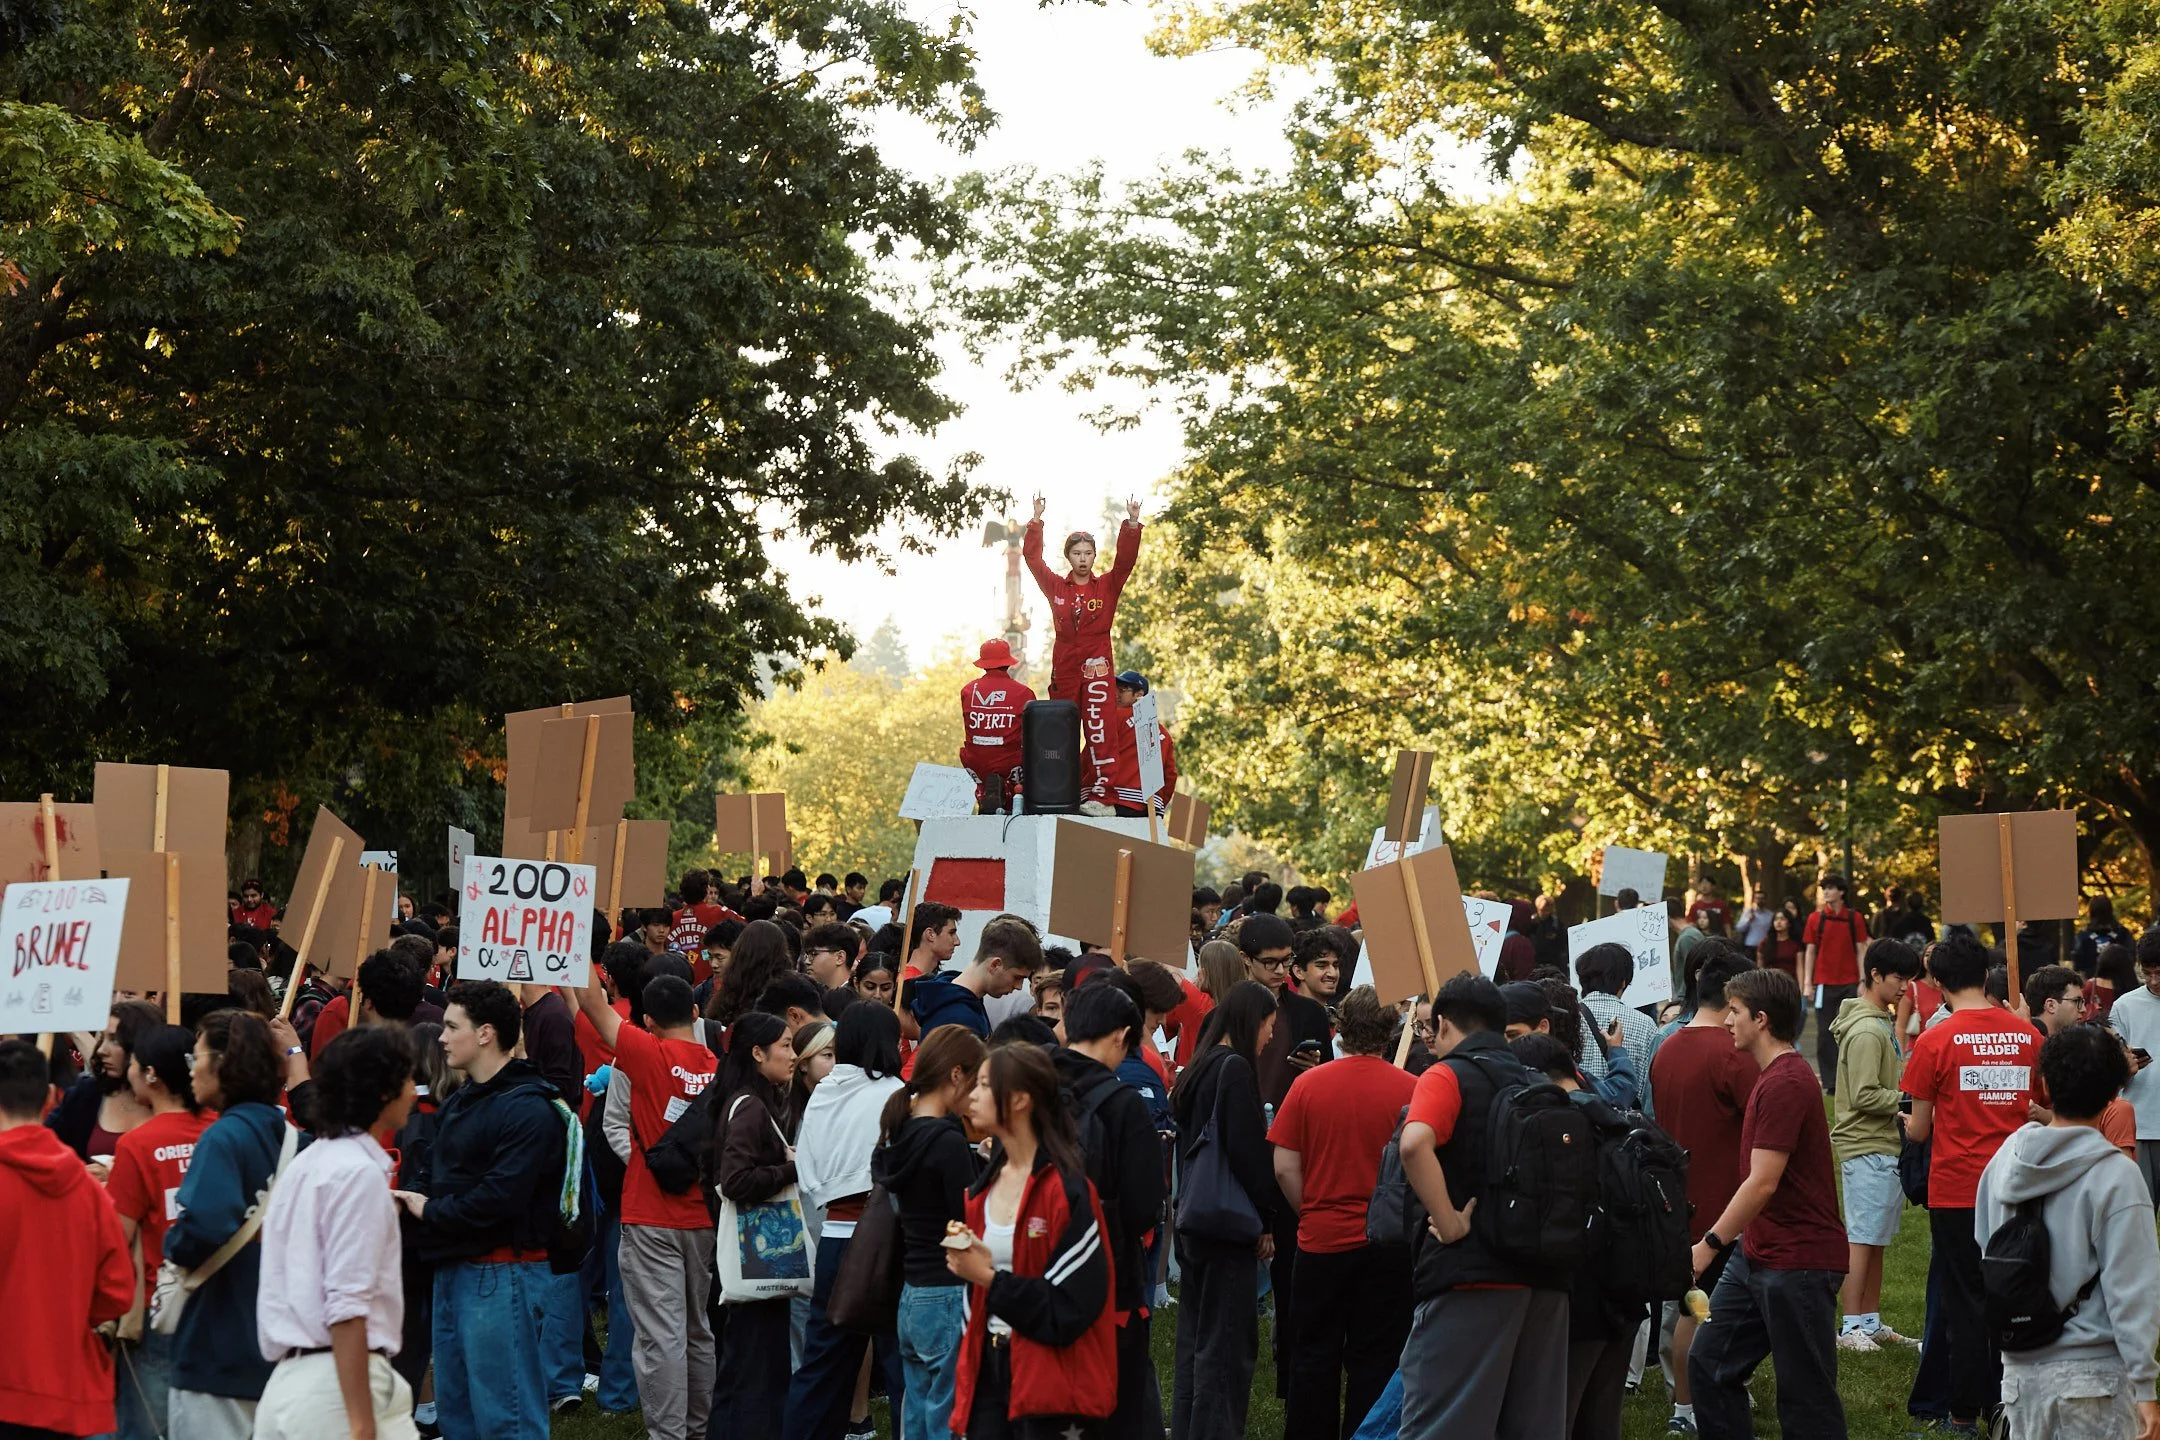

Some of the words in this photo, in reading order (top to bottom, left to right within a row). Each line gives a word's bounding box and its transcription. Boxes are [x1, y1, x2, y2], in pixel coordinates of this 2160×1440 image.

[969, 711, 1016, 729] SPIRIT
[453, 845, 460, 864] E
[489, 863, 571, 902] 200
[42, 886, 78, 913] 200
[482, 906, 575, 953] ALPHA
[680, 935, 700, 945] UBC
[1953, 1032, 2032, 1045] ORIENTATION
[1972, 1045, 2020, 1056] LEADER
[1978, 1092, 2018, 1100] #IAMUBC
